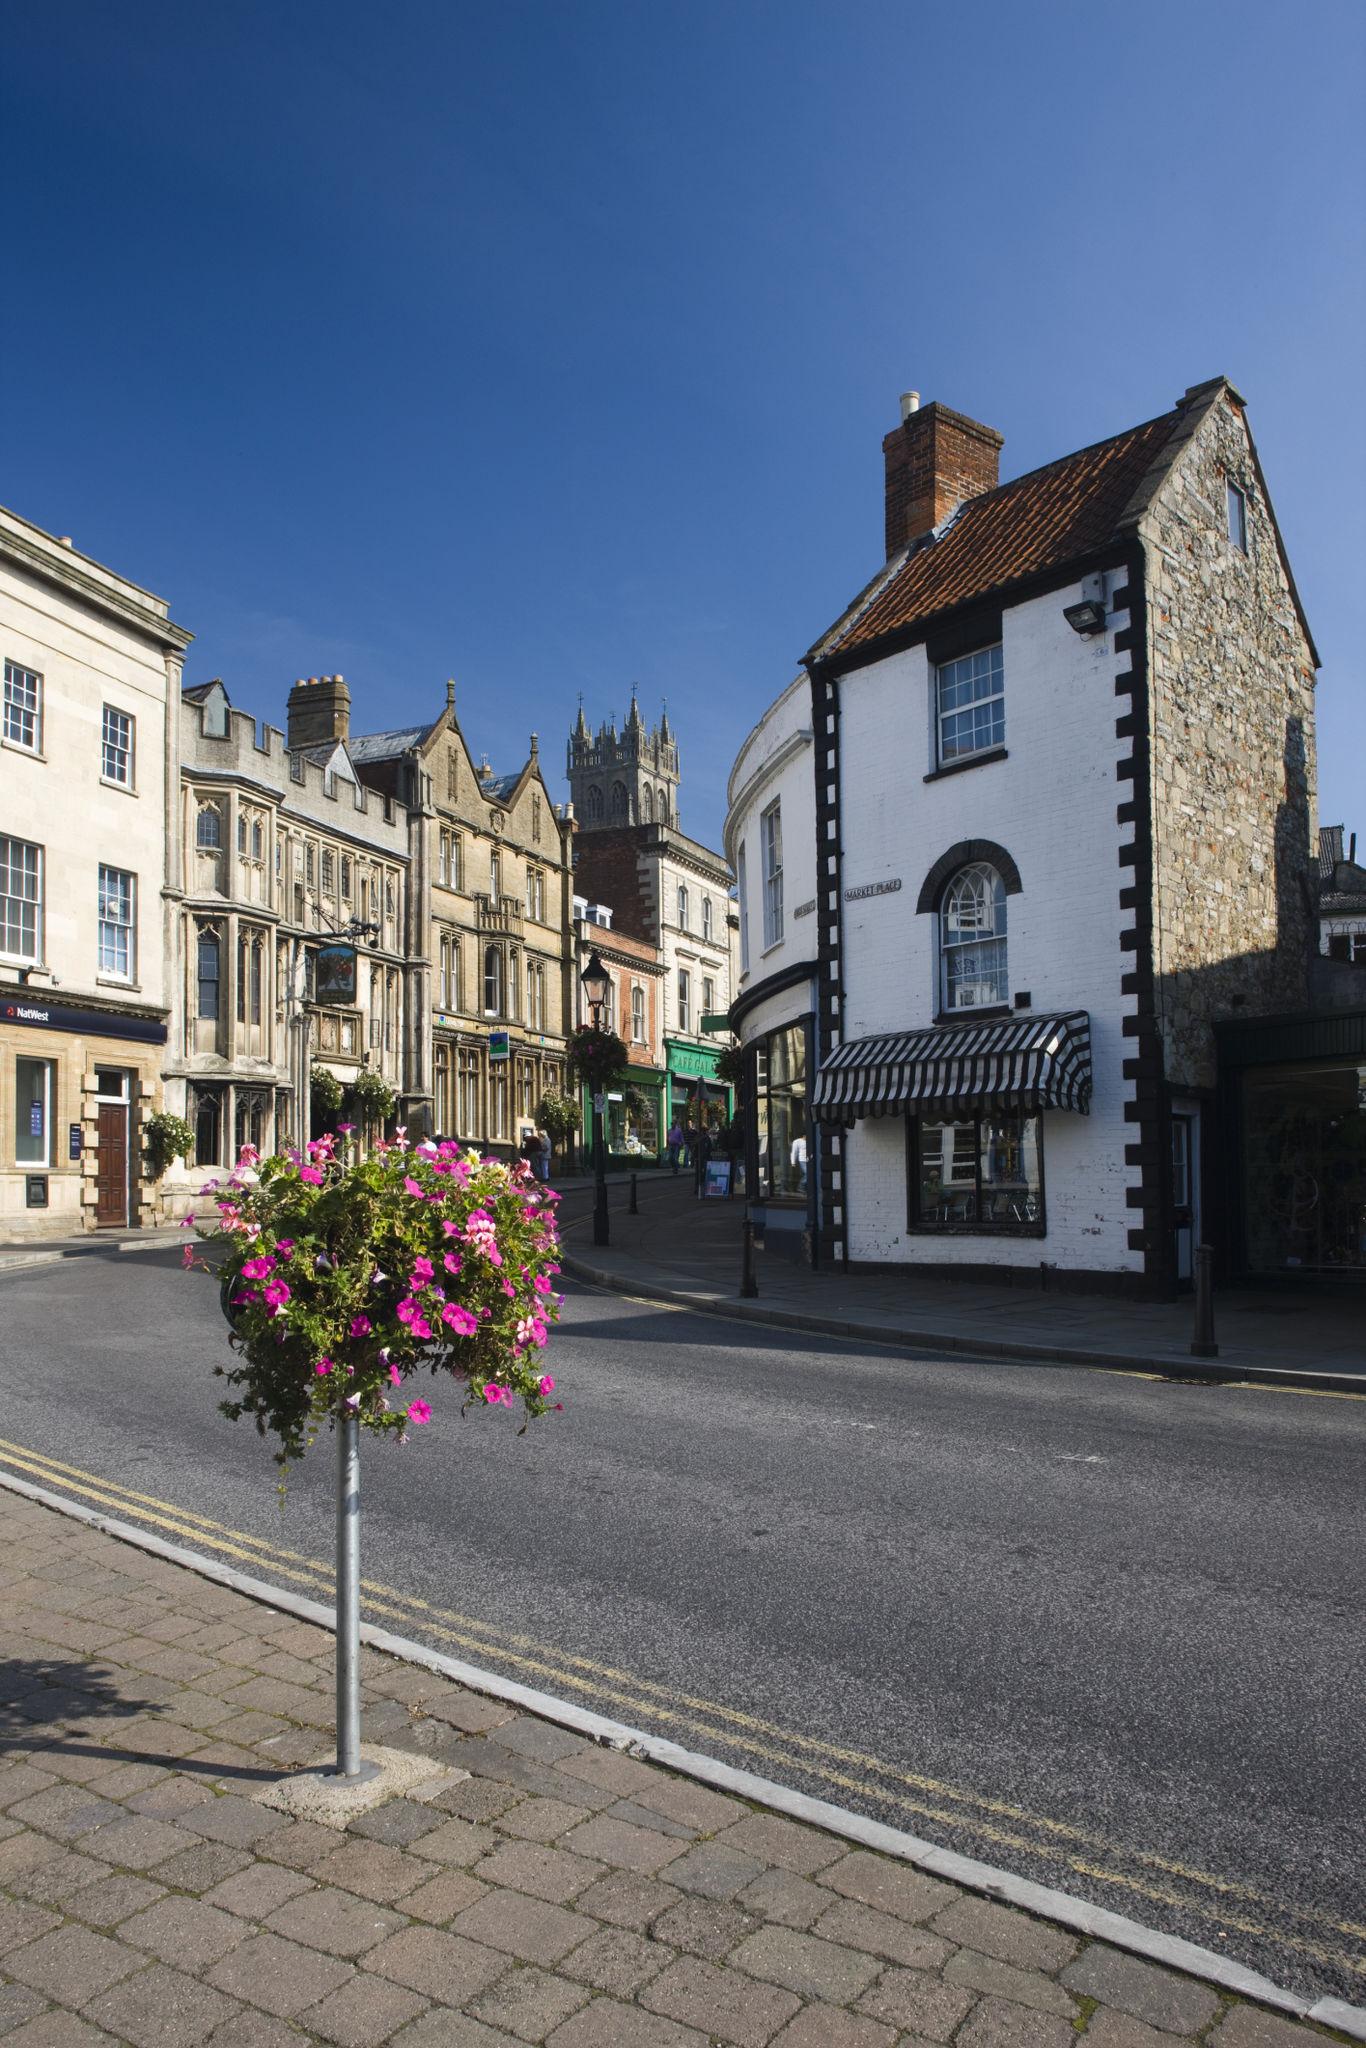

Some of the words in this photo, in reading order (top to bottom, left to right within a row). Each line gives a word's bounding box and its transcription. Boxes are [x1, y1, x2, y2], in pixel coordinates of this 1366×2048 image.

[846, 885, 875, 898] MARKET
[877, 881, 898, 893] PLACE
[16, 1006, 49, 1021] NatWest
